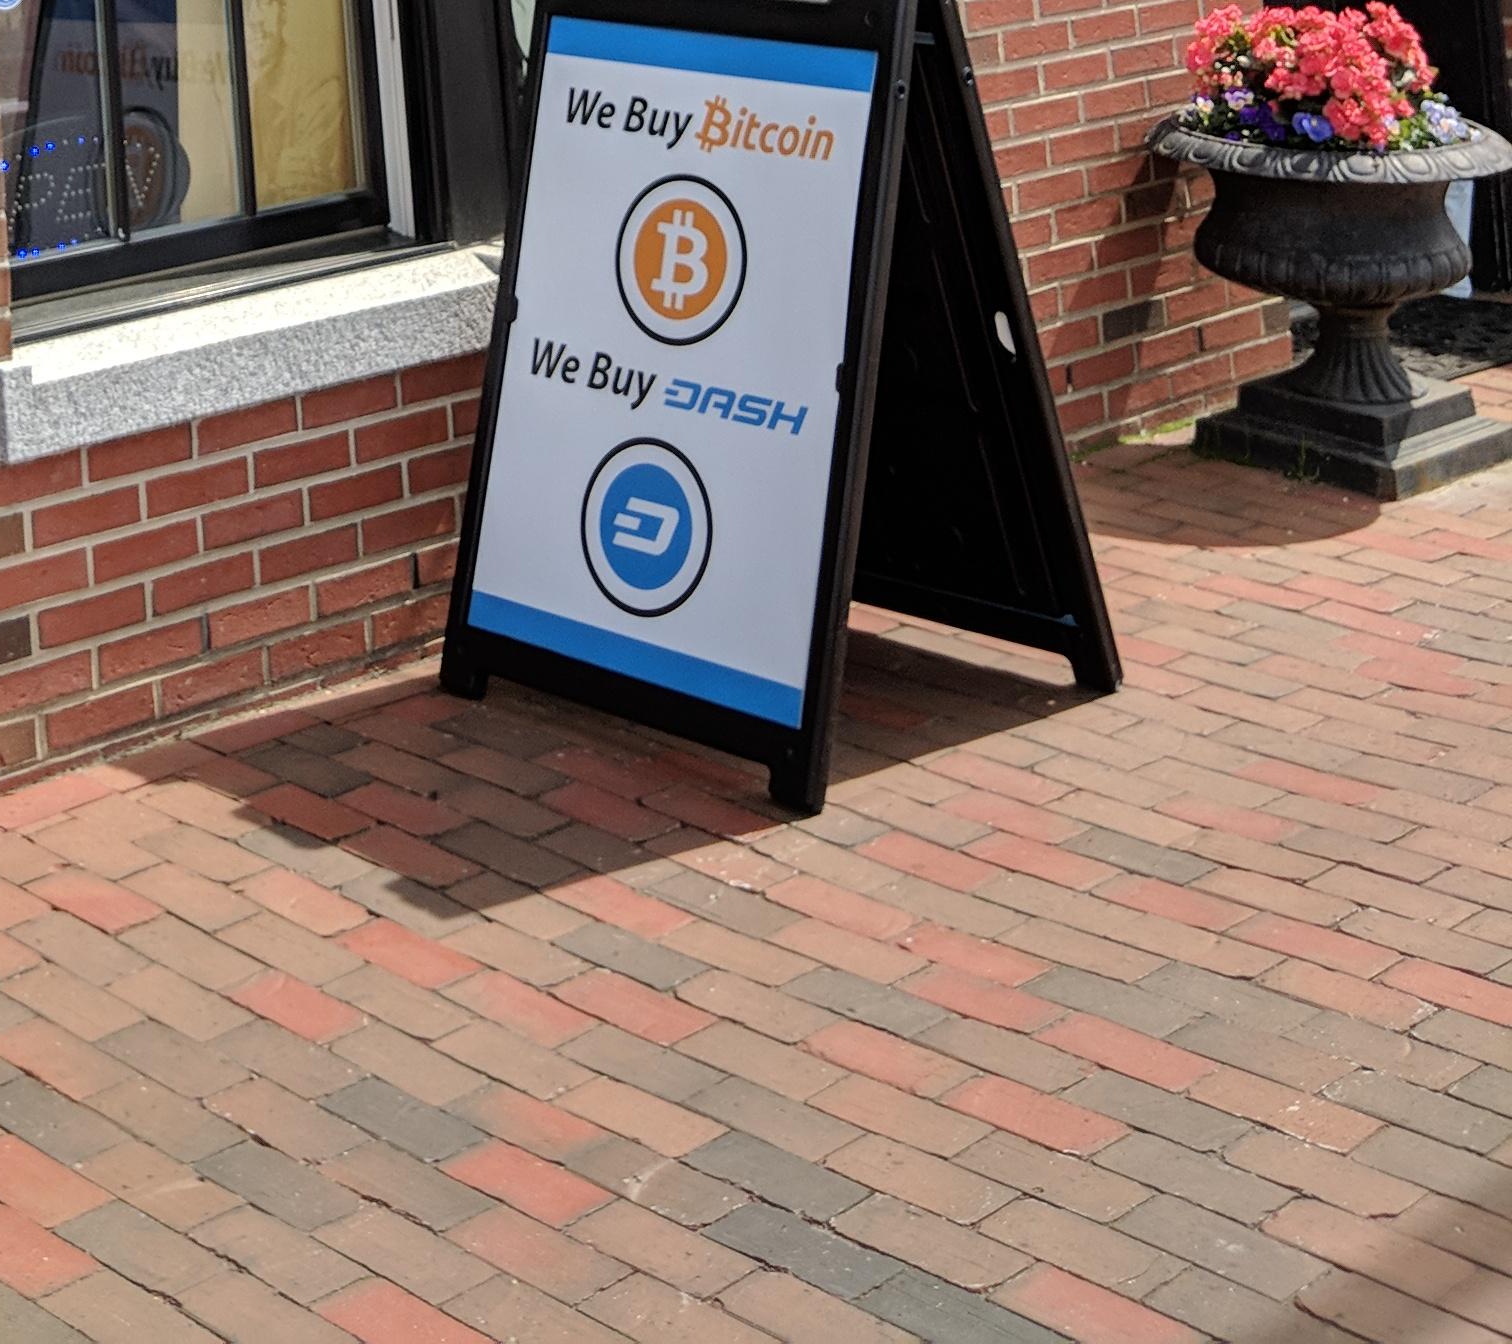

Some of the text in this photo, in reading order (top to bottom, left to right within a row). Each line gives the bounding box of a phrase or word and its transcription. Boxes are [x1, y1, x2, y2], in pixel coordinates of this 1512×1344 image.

[565, 86, 835, 162] We Buy Bitcoin
[530, 336, 811, 439] We Buy DASH
